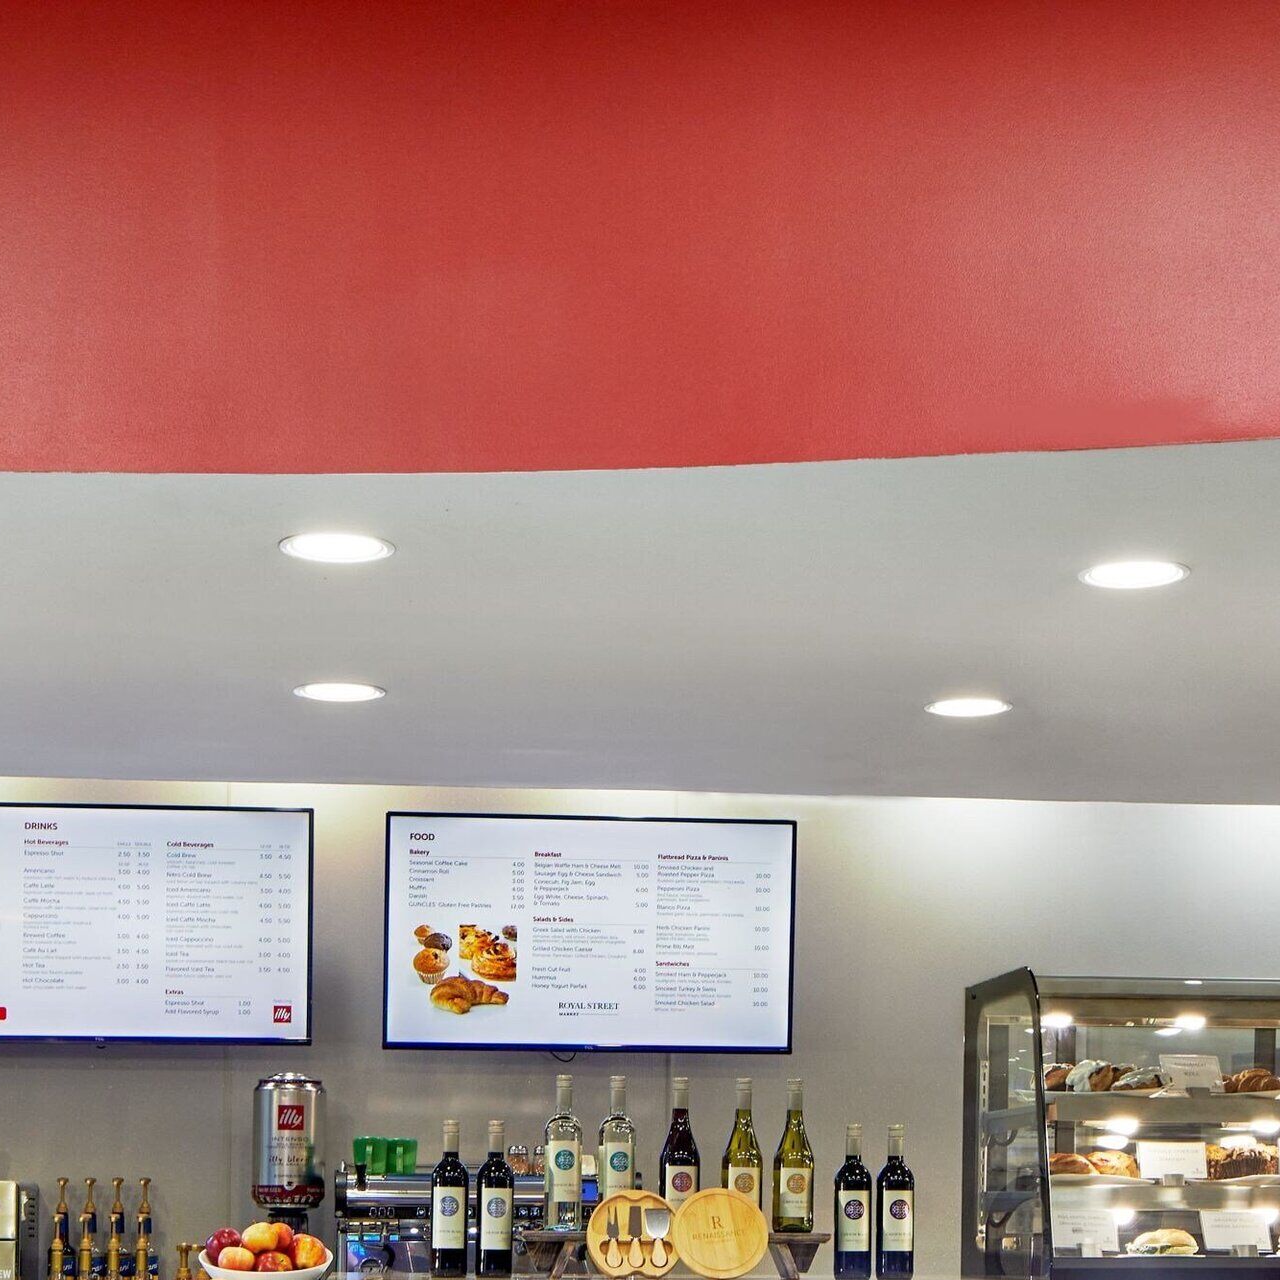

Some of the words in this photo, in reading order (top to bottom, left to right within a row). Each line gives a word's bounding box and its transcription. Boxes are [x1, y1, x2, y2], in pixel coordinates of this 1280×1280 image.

[24, 822, 58, 831] DRINKS
[409, 833, 435, 841] FOOD
[37, 839, 69, 847] Beverages
[182, 841, 214, 849] Beverages
[409, 849, 430, 857] Bakery
[587, 1002, 619, 1010] STREET
[274, 1008, 291, 1022] illy
[279, 1109, 303, 1128] illy
[711, 1216, 724, 1230] R
[692, 1229, 744, 1240] RENAISSANCE
